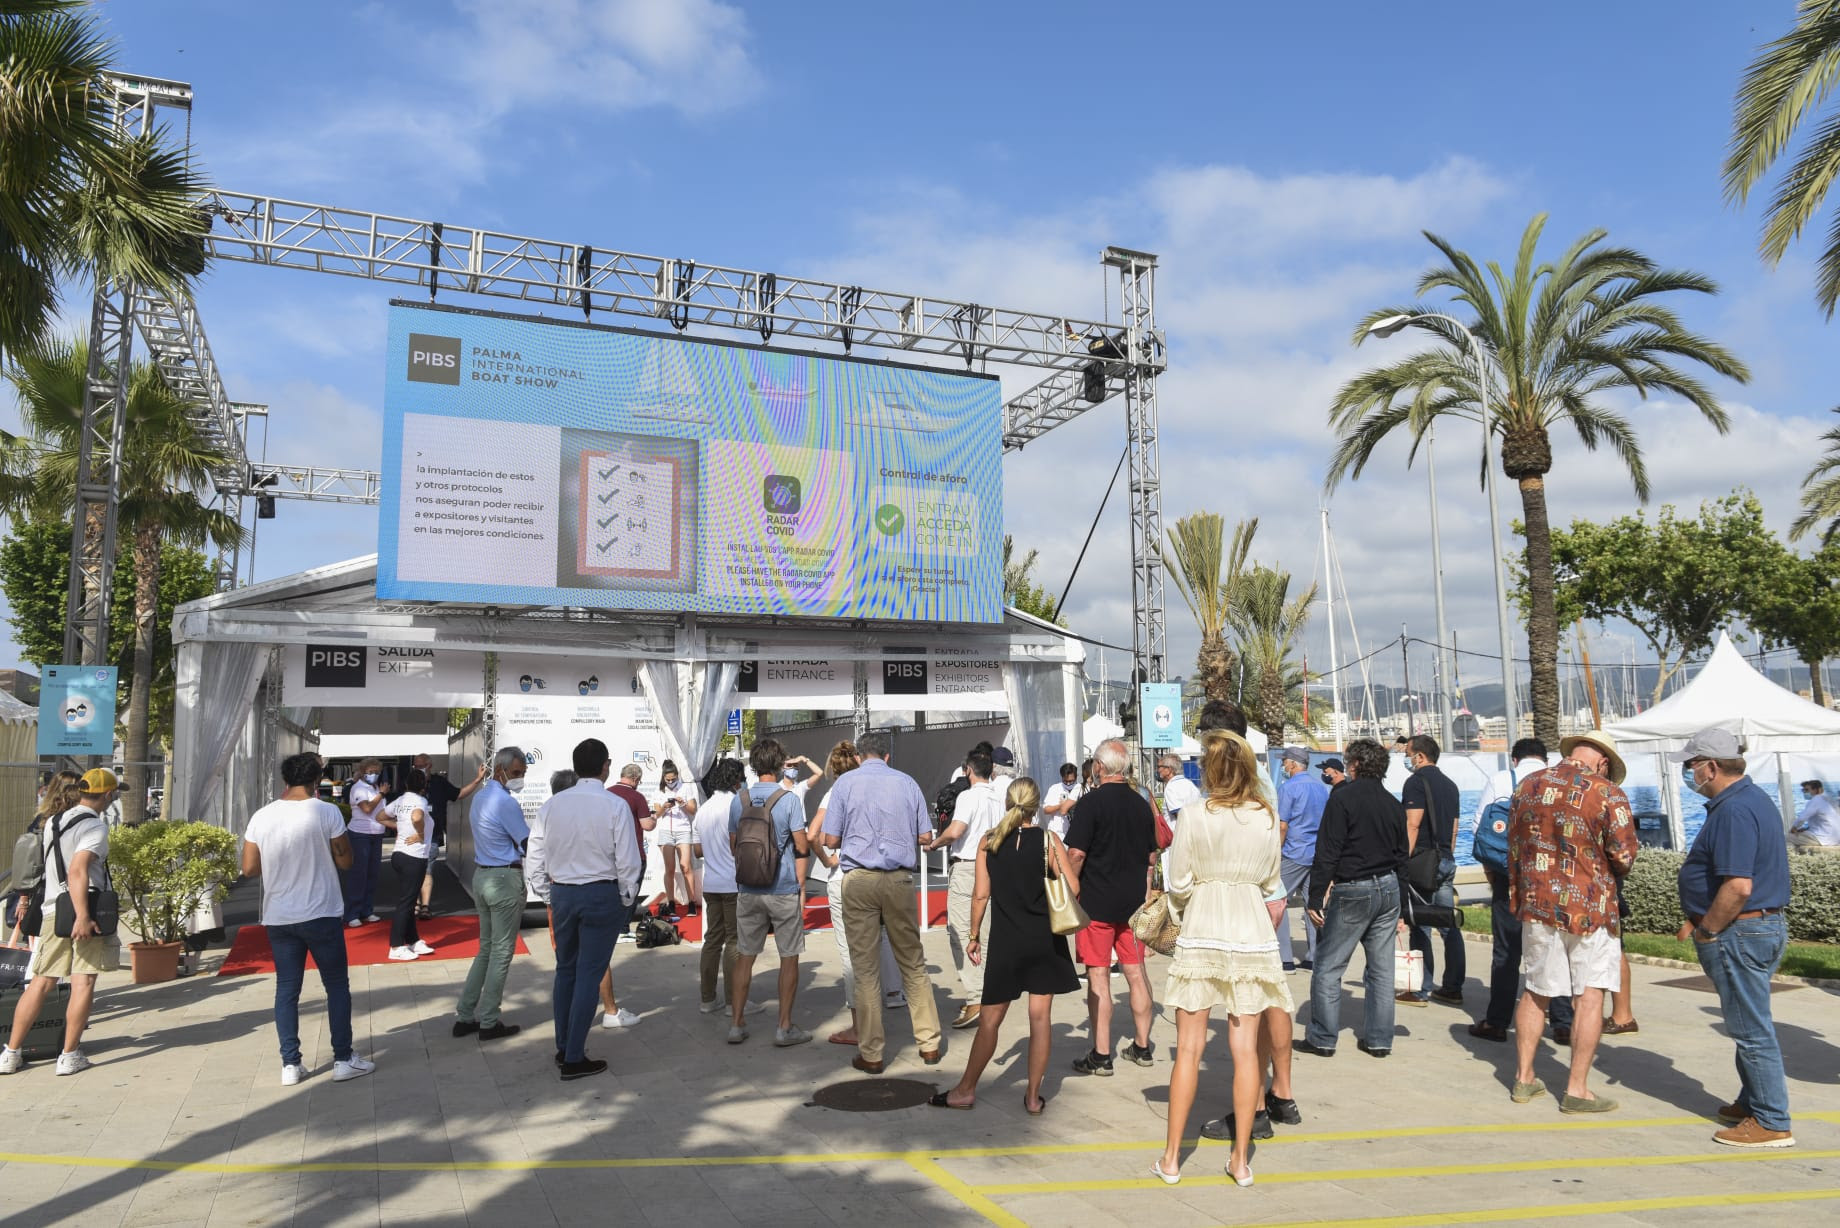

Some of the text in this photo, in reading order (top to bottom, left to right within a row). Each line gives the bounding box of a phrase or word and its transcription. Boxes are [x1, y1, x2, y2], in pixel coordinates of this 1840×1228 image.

[413, 350, 456, 368] PIBS
[473, 347, 522, 360] PALMA
[472, 359, 585, 380] INTERNATIONAL
[472, 372, 559, 388] BOAT SHOW
[416, 464, 535, 481] la implantación de estos
[880, 468, 968, 484] Control de aforo
[415, 481, 503, 494] y otros protocolos
[416, 496, 544, 511] nos aseguran poder recibir
[422, 512, 480, 522] expositores
[481, 516, 488, 524] y
[489, 515, 534, 524] visitantes
[766, 515, 800, 526] RADAR
[766, 526, 795, 536] COVID
[916, 518, 972, 532] ACCEDA
[414, 526, 427, 534] en
[429, 526, 443, 534] las
[445, 528, 484, 538] mejores
[916, 533, 972, 548] COME IN
[727, 566, 751, 576] PLEASE
[752, 566, 768, 576] HAVE
[769, 567, 782, 576] THE
[782, 568, 803, 578] RADAR
[804, 568, 822, 578] COVID
[740, 578, 823, 590] INSTALLED ON YOUR PHONE
[378, 647, 434, 657] SALIDA
[312, 651, 360, 667] PIBS
[378, 662, 410, 672] EXIT
[888, 664, 923, 677] PIBS
[768, 670, 835, 680] ENTRANCE
[935, 674, 990, 682] EXHIBITORS
[935, 684, 985, 694] ENTRANCE
